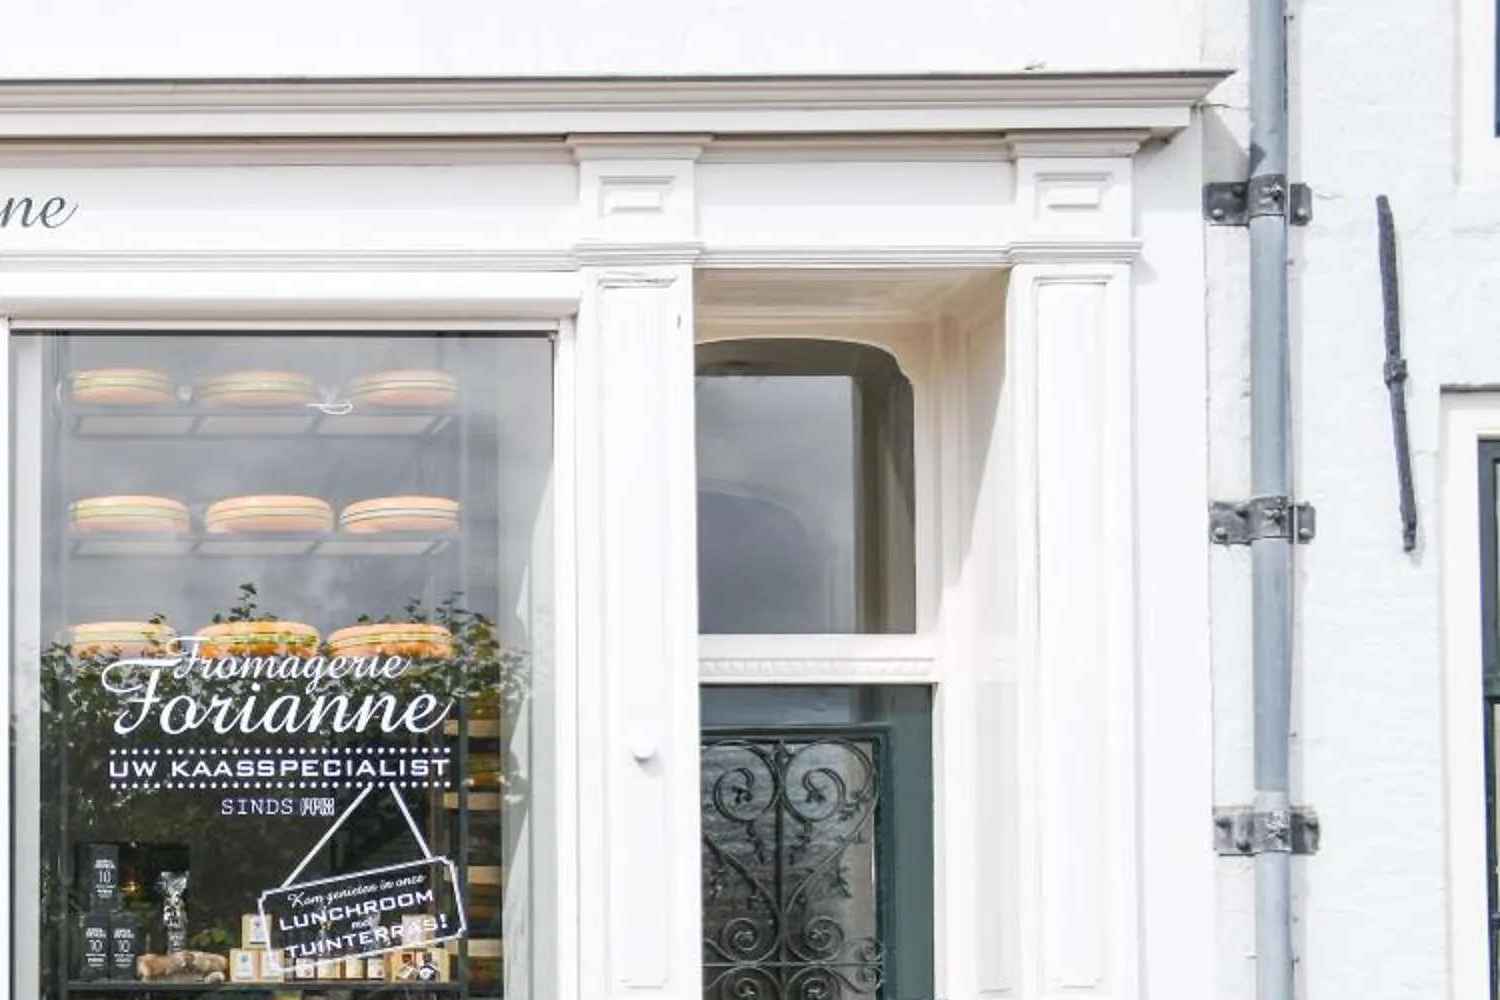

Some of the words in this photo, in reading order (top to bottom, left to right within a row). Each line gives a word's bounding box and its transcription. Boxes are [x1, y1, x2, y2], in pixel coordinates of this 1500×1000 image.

[166, 635, 412, 695] Fromagerie
[102, 657, 455, 735] Forianne
[109, 760, 157, 777] UW
[171, 759, 452, 777] KAASSPECIALIST
[221, 797, 293, 815] SINDS
[279, 889, 435, 931] LUNCHROOM
[285, 913, 449, 959] TUINTERRAS!
